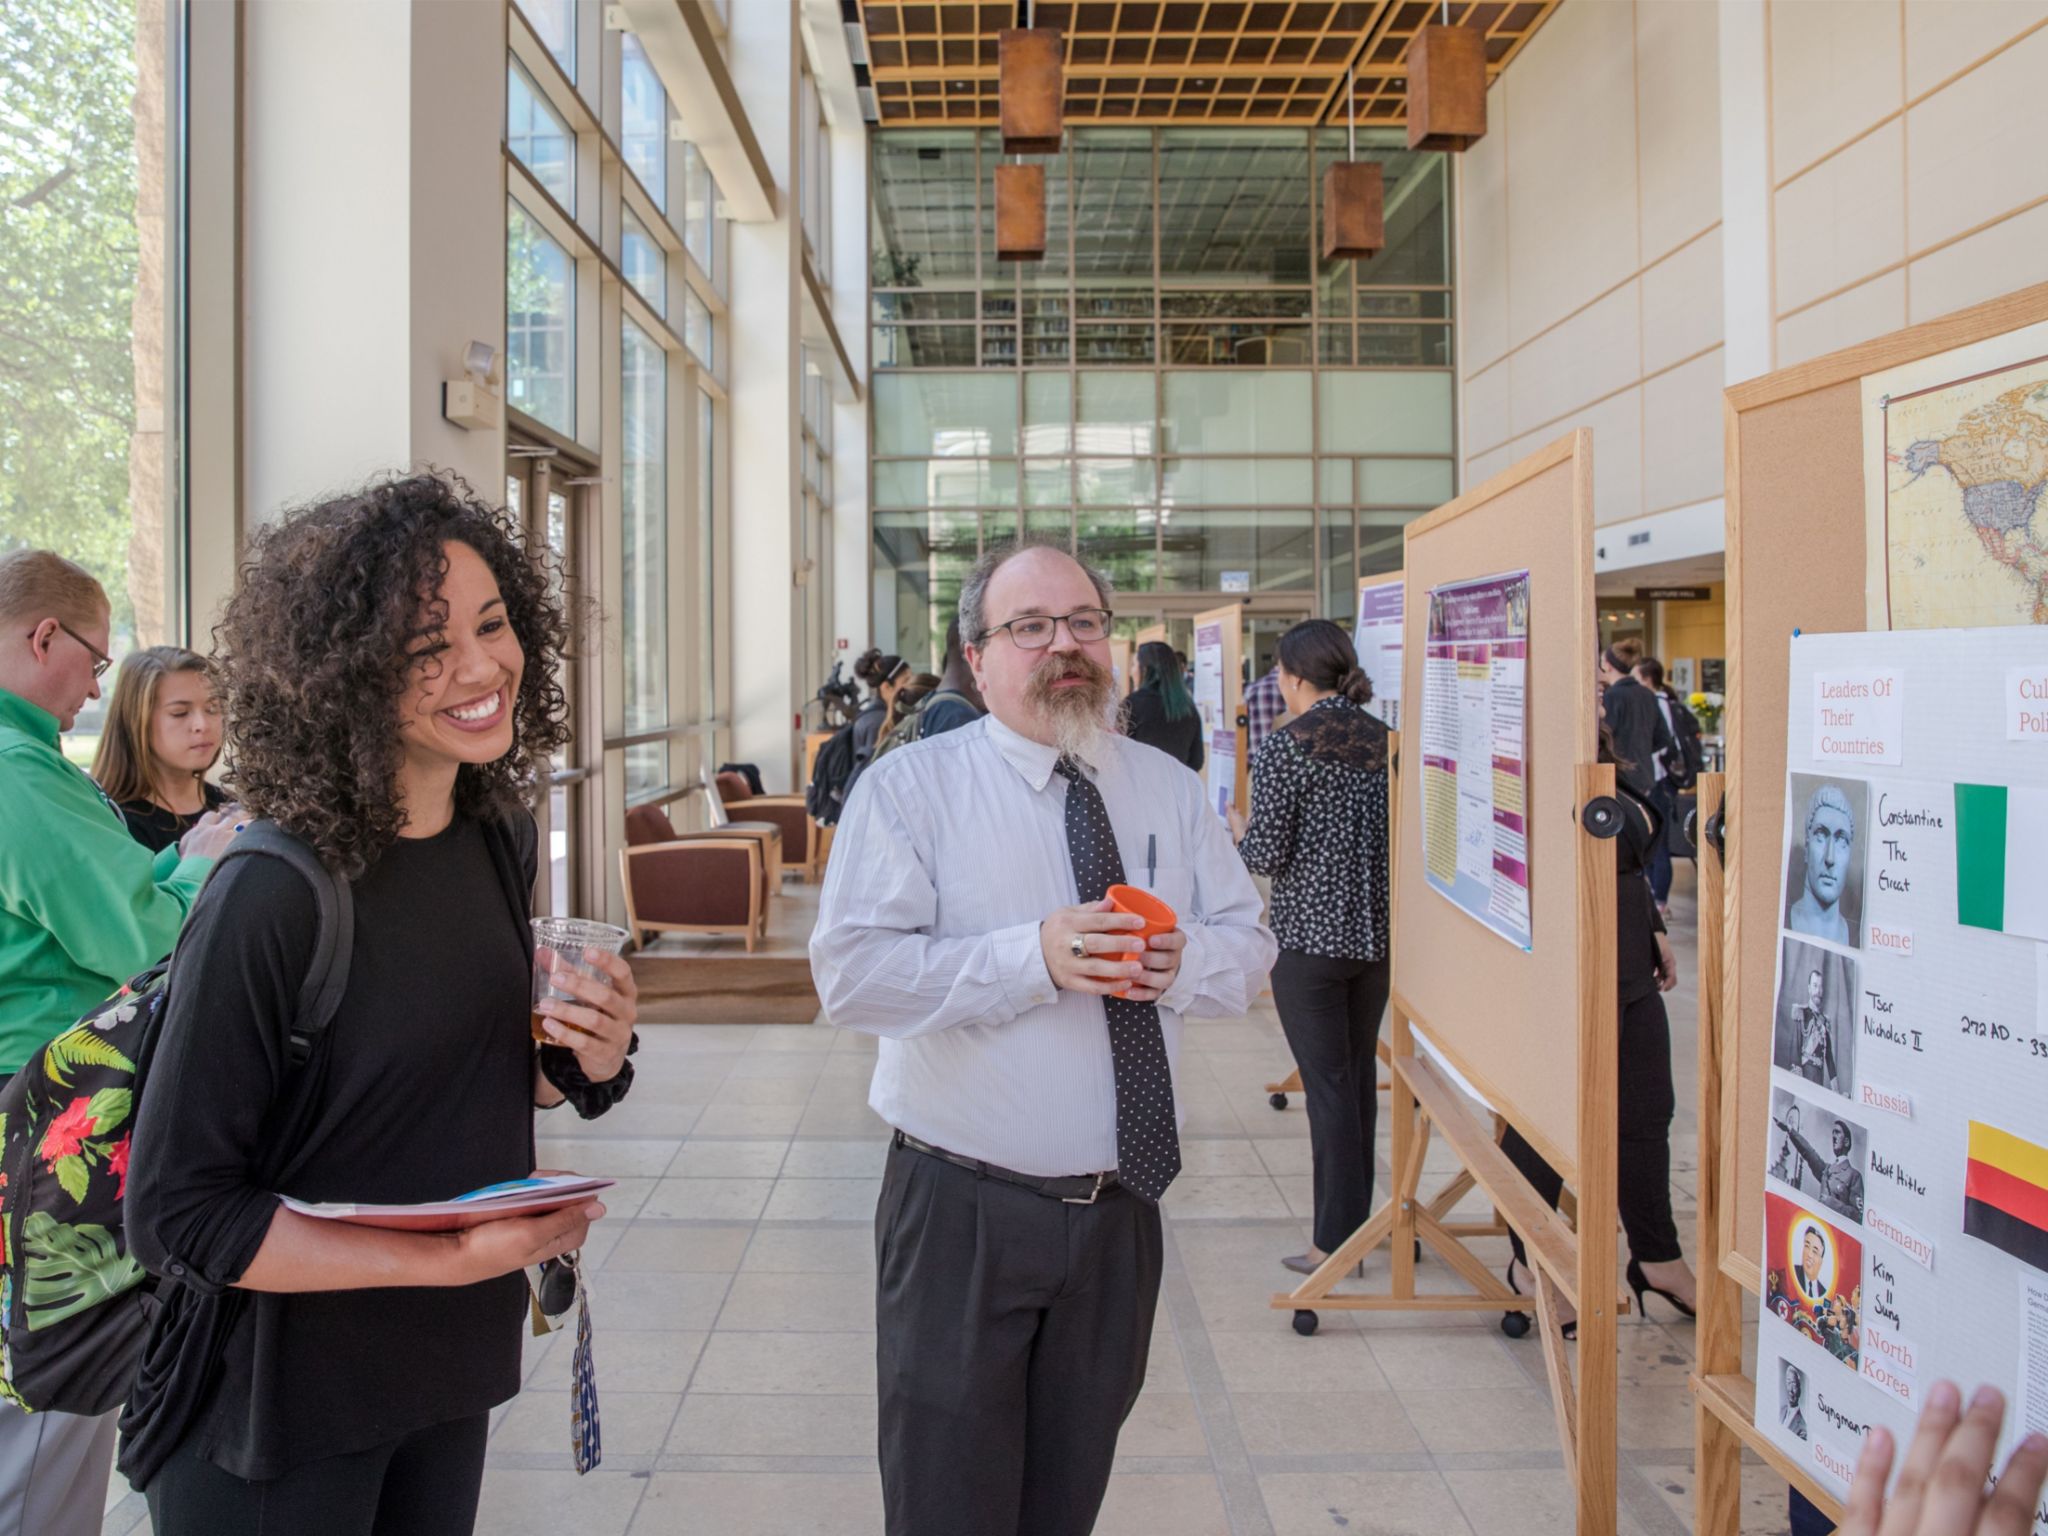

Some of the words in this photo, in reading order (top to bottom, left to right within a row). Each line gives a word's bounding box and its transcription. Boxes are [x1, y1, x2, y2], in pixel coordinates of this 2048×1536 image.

[1821, 680, 1869, 699] Leaders
[1872, 678, 1893, 697] Of
[1821, 708, 1854, 726] Their
[1821, 736, 1885, 755] Countries
[1878, 793, 1943, 828] Constantine
[1882, 840, 1908, 862] The
[1878, 869, 1911, 892] Great
[1871, 927, 1911, 949] Rome
[1865, 990, 1893, 1013] Tsar
[1864, 1015, 1907, 1046] Nicholas
[1961, 1015, 1987, 1037] 272
[1990, 1022, 2010, 1041] AD
[1863, 1085, 1909, 1115] Russia
[1871, 1150, 1894, 1179] Adolf
[1896, 1164, 1927, 1196] Hitler
[1866, 1208, 1932, 1265] Germany
[1872, 1254, 1895, 1286] Kim
[1874, 1294, 1900, 1331] Sung
[1867, 1327, 1913, 1369] North
[1863, 1355, 1910, 1399] Korea
[1817, 1393, 1861, 1436] Syngman
[1815, 1444, 1854, 1486] South
